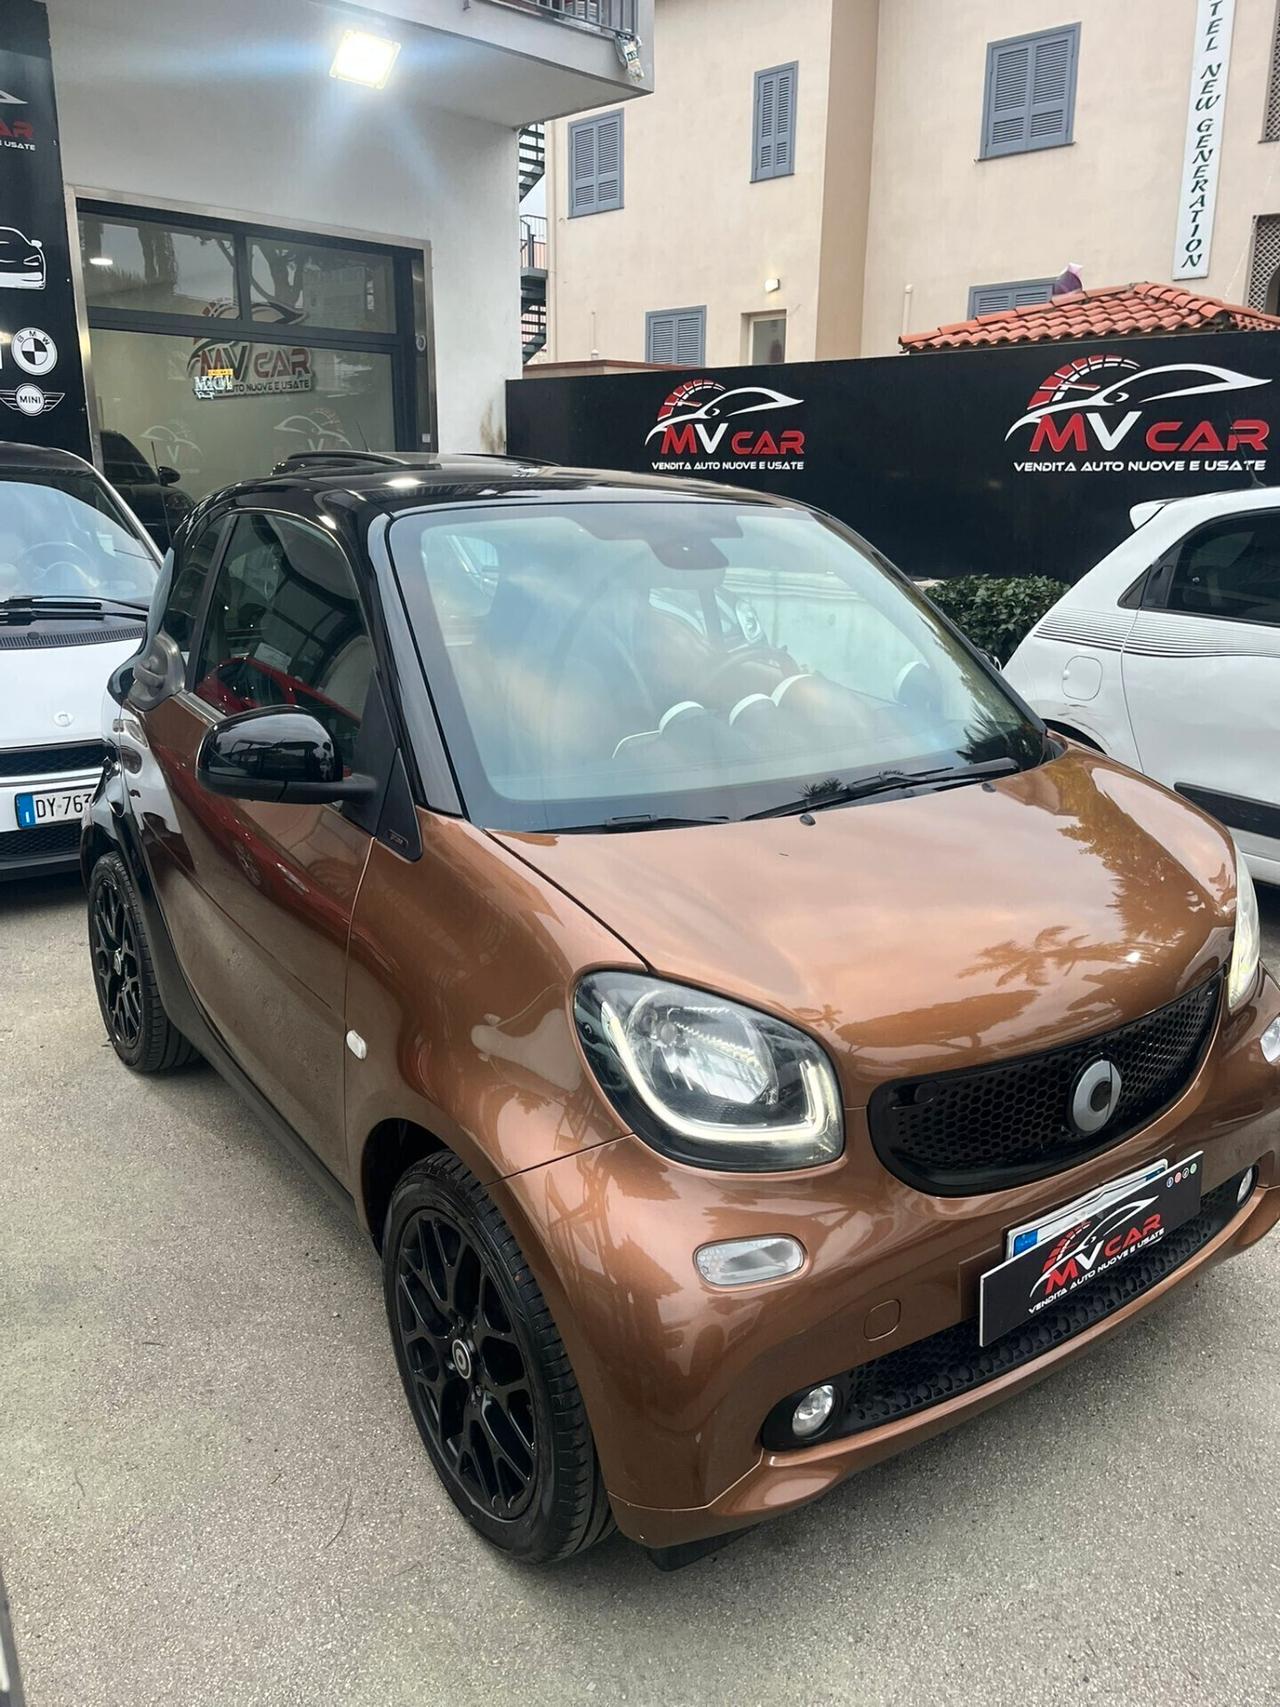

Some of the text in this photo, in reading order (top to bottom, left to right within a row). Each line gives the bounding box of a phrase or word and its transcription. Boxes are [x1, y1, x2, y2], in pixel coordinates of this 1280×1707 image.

[0, 118, 33, 139] AR
[1181, 0, 1223, 269] TEL NEW GENERATION
[3, 140, 36, 151] USATE
[17, 330, 50, 345] BMW
[200, 345, 311, 380] MV CAR
[246, 382, 274, 393] NUOVE
[274, 382, 280, 391] E
[282, 379, 310, 391] USATE
[19, 395, 41, 404] MINI
[660, 423, 805, 455] MV CAR
[1029, 411, 1270, 453] MV CAR
[652, 461, 805, 471] VENDITA AUTO NUOVE E USATE
[1013, 459, 1267, 473] VENDITA AUTO NUOVE E USATE
[36, 797, 56, 818] DY
[1045, 1213, 1161, 1295] MV CAR
[1028, 1227, 1165, 1314] VENDITA AUTO NUOVE E USATE
